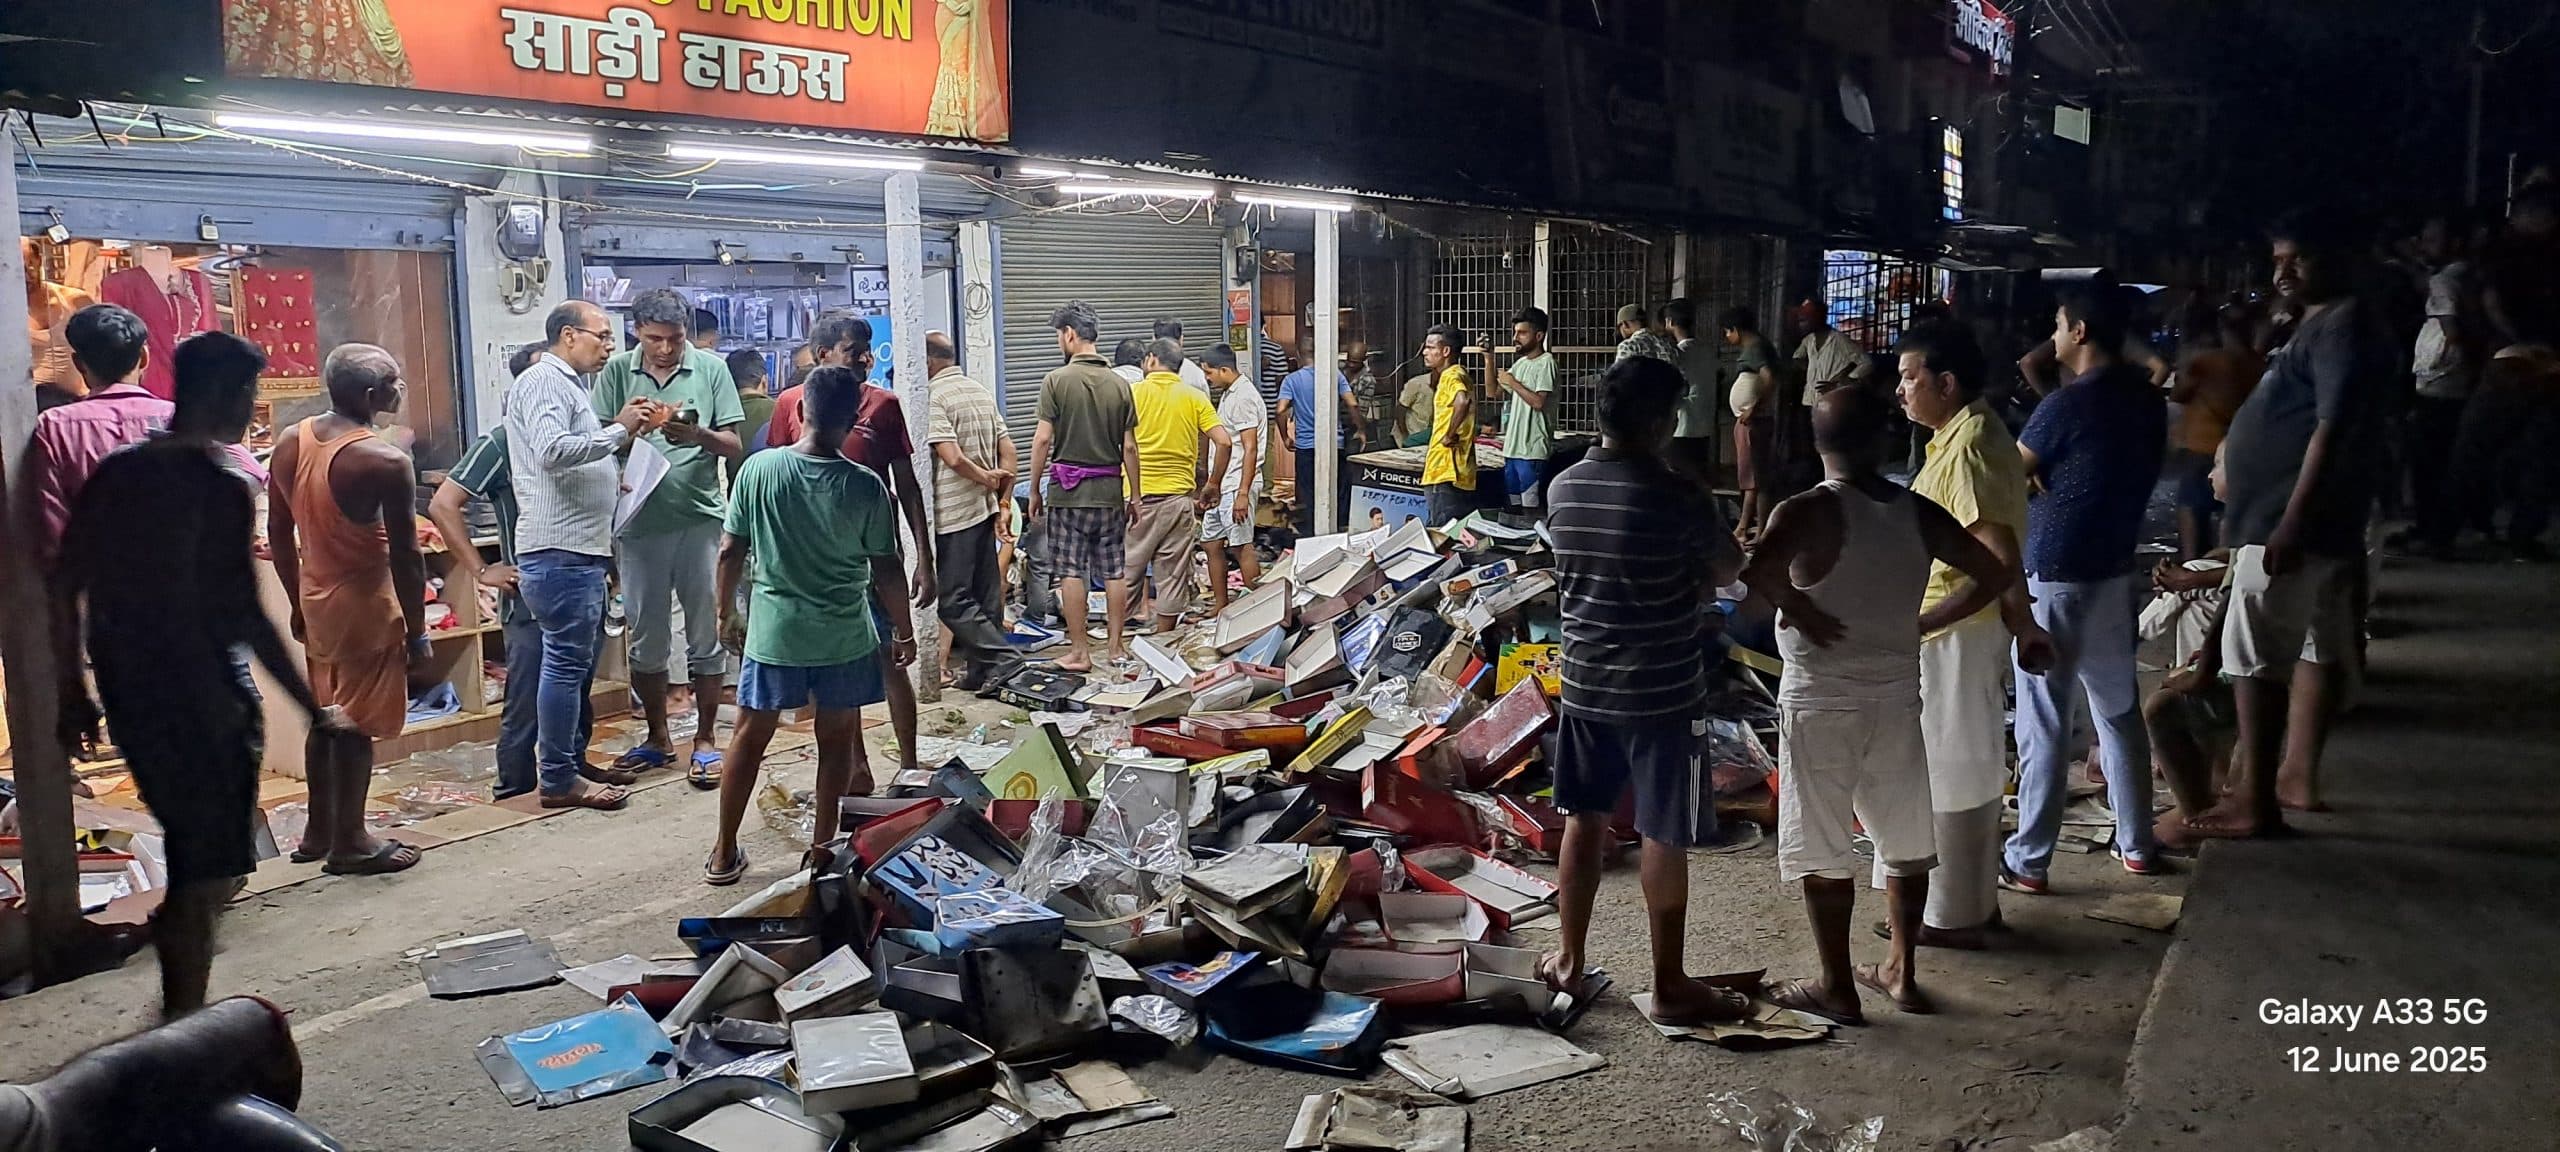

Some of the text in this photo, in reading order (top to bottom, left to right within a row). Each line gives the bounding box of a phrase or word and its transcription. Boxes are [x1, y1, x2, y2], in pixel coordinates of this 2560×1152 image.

[501, 9, 850, 102] साड़ी हाऊस
[1380, 472, 1411, 484] FORCE
